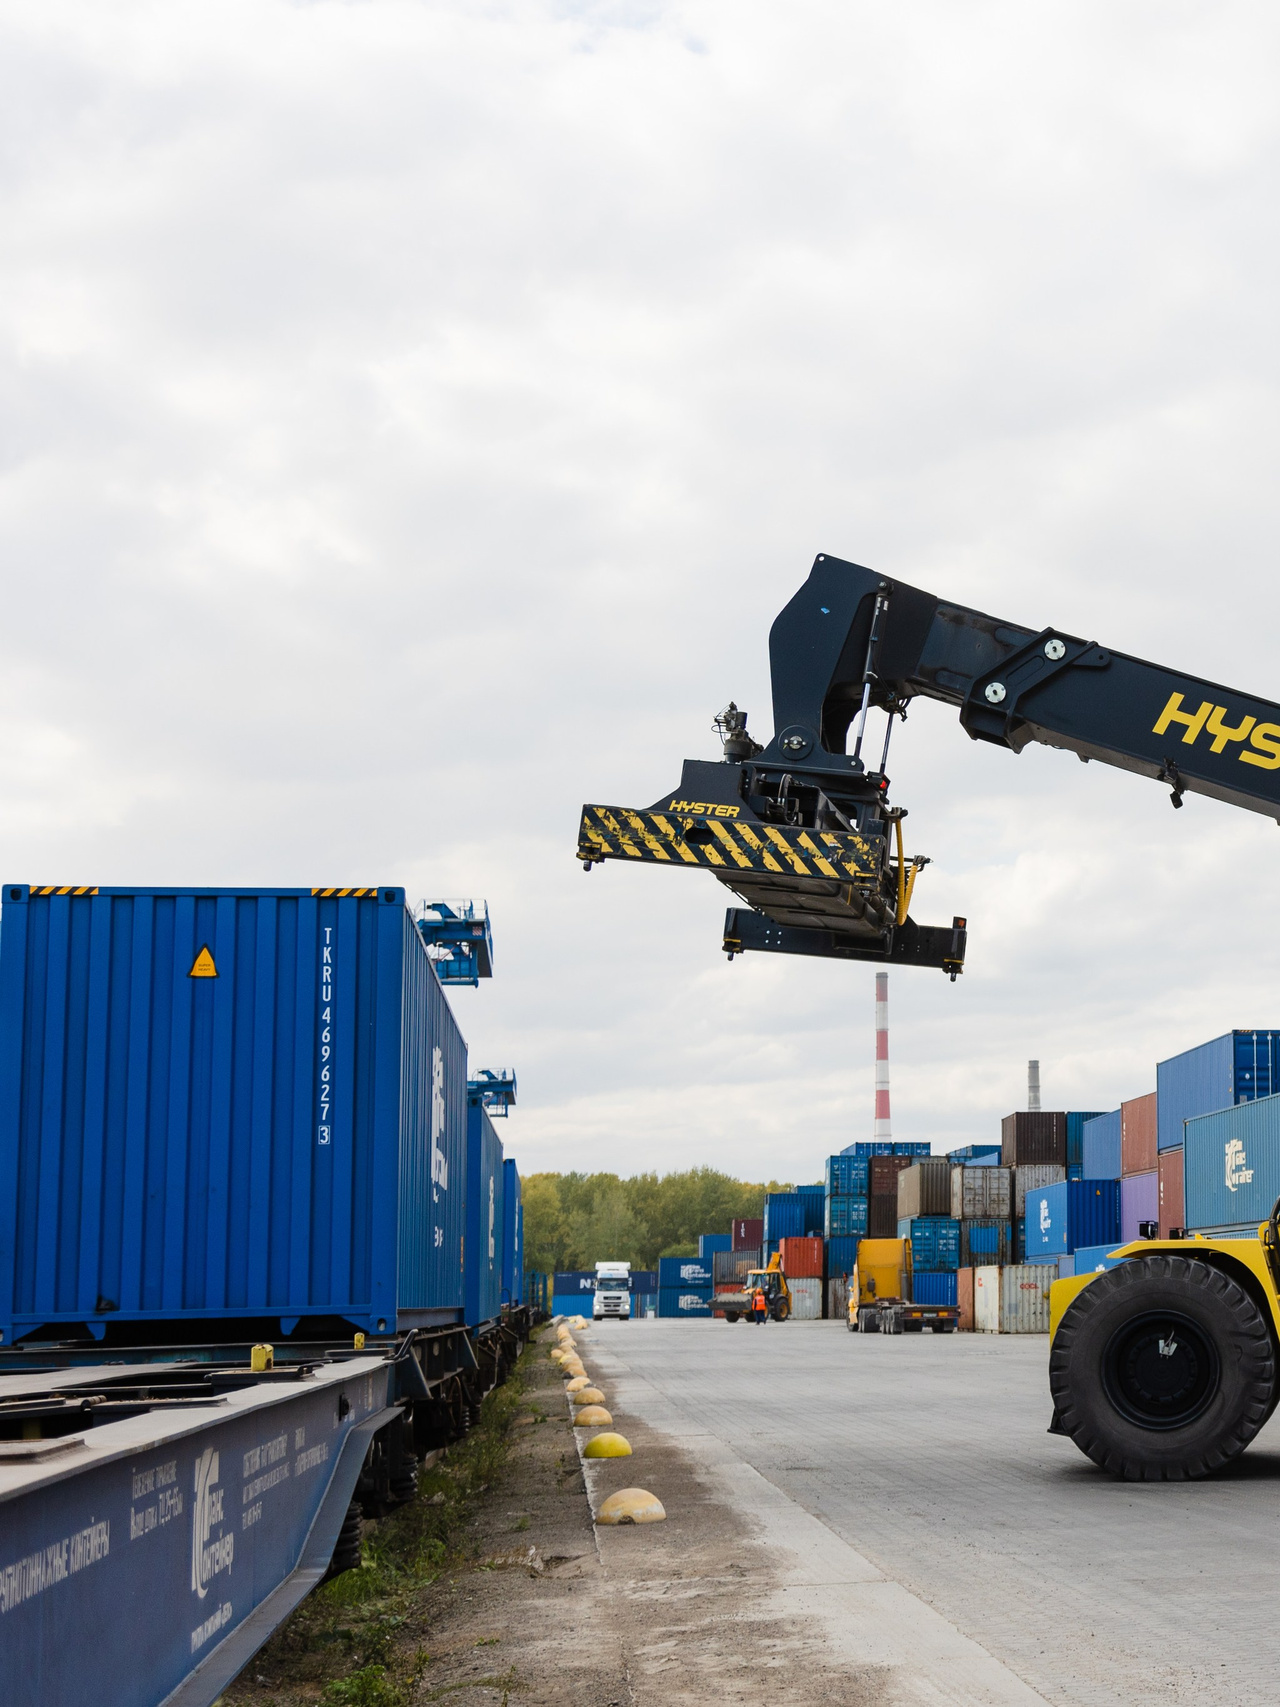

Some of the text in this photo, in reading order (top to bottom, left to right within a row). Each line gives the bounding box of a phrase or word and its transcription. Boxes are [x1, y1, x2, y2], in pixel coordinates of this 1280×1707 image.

[668, 799, 740, 819] HYSTER
[318, 927, 332, 1145] TKRU 469627 3
[70, 1516, 110, 1575] КОНТЕЙНЕРЫ
